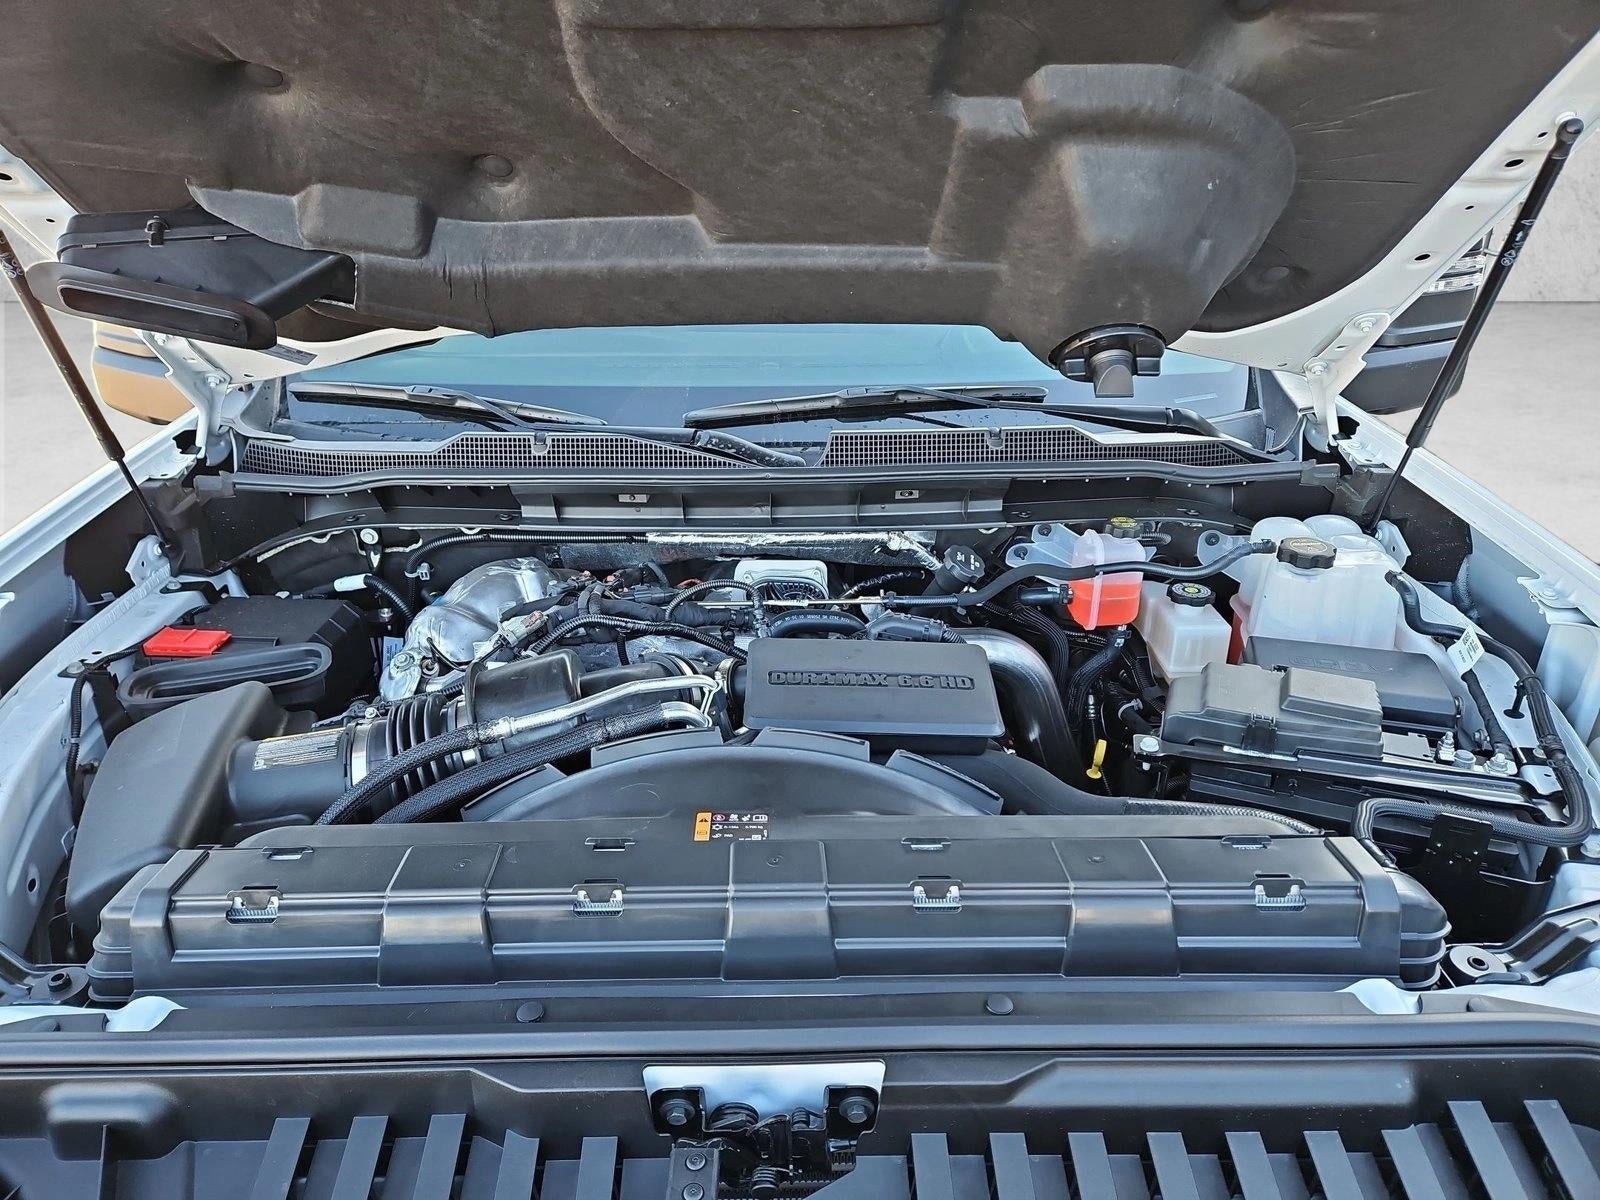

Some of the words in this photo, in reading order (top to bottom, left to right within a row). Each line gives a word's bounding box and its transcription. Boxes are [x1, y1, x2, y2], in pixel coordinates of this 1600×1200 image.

[770, 671, 888, 686] DURAMAX
[897, 674, 934, 688] 6.6
[940, 675, 973, 689] HD
